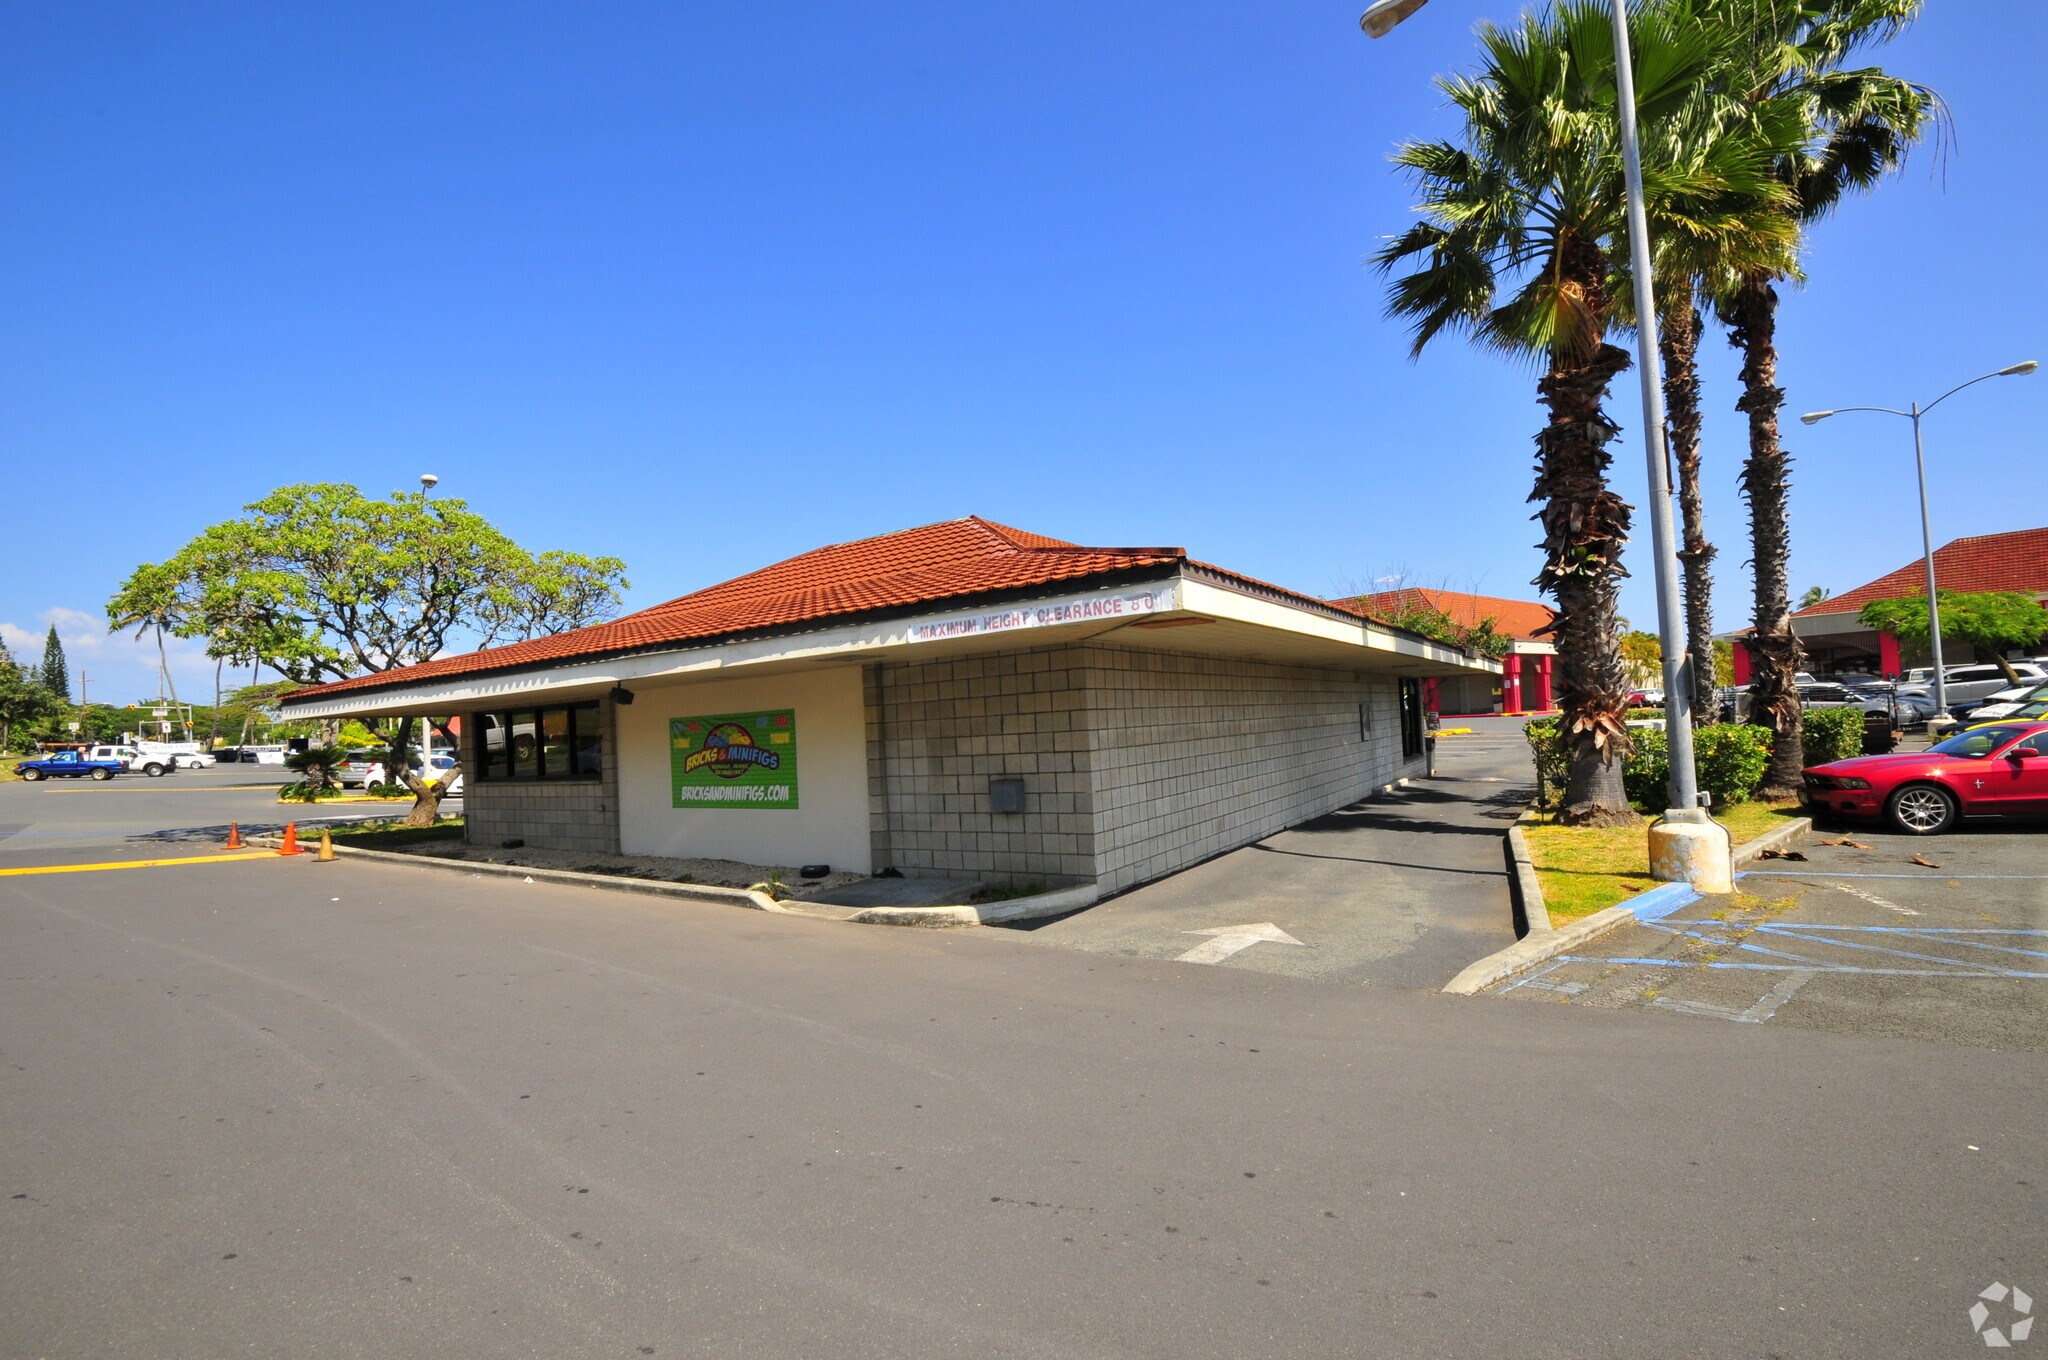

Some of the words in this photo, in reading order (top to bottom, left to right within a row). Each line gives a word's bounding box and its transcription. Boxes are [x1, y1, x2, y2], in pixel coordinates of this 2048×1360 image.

[920, 618, 977, 639] MAXIMUM
[984, 611, 1029, 631] HEIGHT
[1037, 599, 1122, 622] CLEARANCE
[686, 748, 718, 772] BRICKS
[719, 749, 727, 760] &
[728, 746, 778, 768] MINIFIGS
[682, 785, 789, 801] BRICKSANDMINIFIGS.COM
